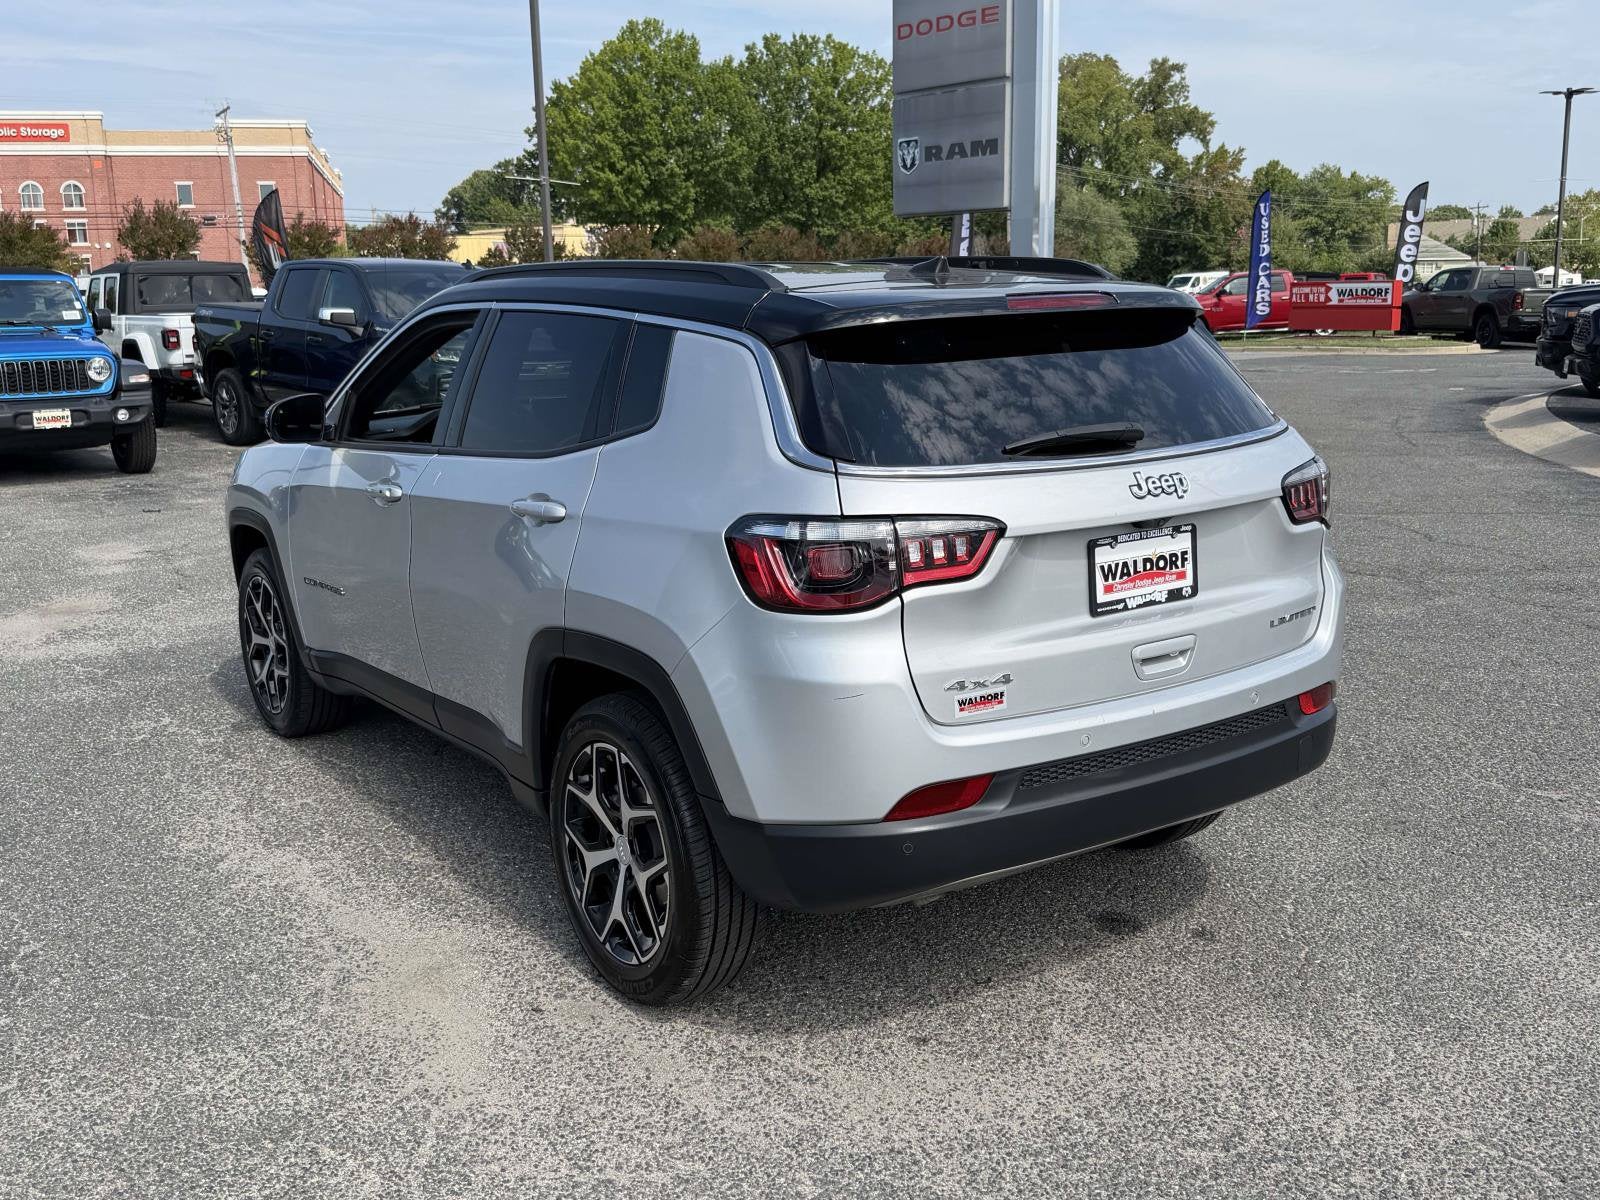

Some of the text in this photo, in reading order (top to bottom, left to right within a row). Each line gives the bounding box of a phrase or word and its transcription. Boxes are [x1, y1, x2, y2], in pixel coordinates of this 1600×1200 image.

[897, 5, 1000, 40] DODGE
[20, 127, 65, 139] Storage
[924, 138, 999, 162] RAM
[1396, 199, 1426, 282] Jeep
[1256, 203, 1271, 316] USED CARS
[1292, 293, 1326, 303] ALL NEW
[1337, 287, 1390, 298] WALDORF
[1129, 471, 1188, 499] Jeep
[1117, 532, 1140, 543] DEDICATED
[1141, 531, 1147, 539] TO
[1147, 527, 1173, 538] EXCELLENCE
[1100, 550, 1189, 583] WALDORF
[1165, 574, 1177, 582] Ram
[1125, 590, 1168, 609] WALDORF
[943, 672, 1014, 691] 4x4
[957, 691, 1005, 707] WALDORF
